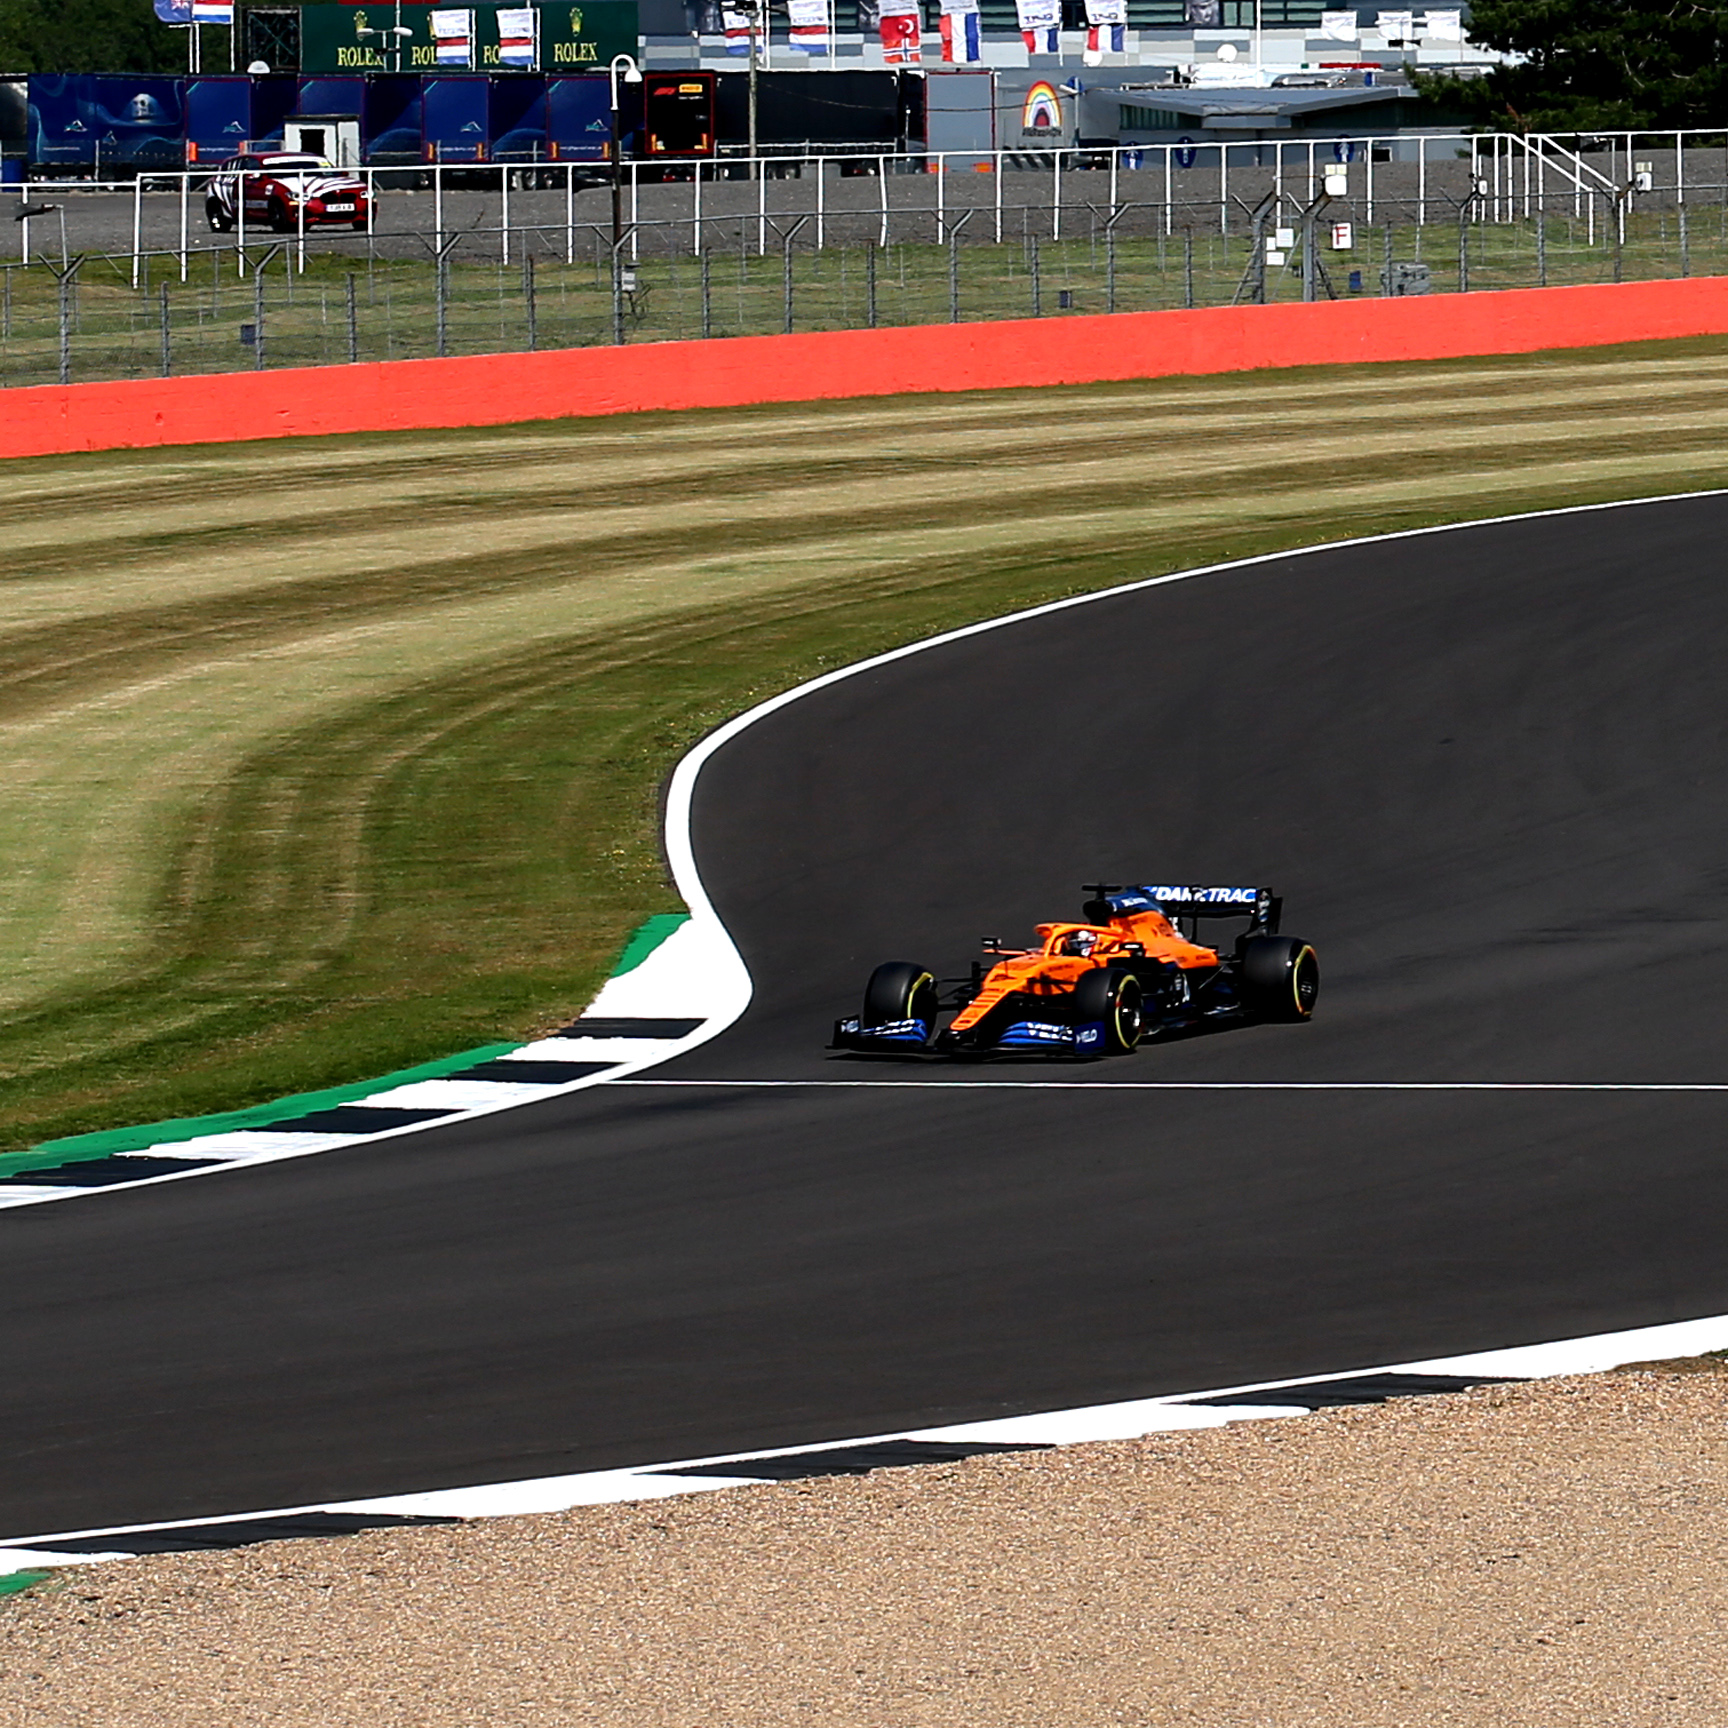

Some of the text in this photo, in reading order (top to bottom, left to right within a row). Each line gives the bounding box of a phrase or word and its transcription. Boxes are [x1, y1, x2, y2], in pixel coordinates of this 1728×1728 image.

[411, 46, 437, 65] ROL
[554, 42, 598, 62] ROLEX
[1335, 226, 1348, 246] F
